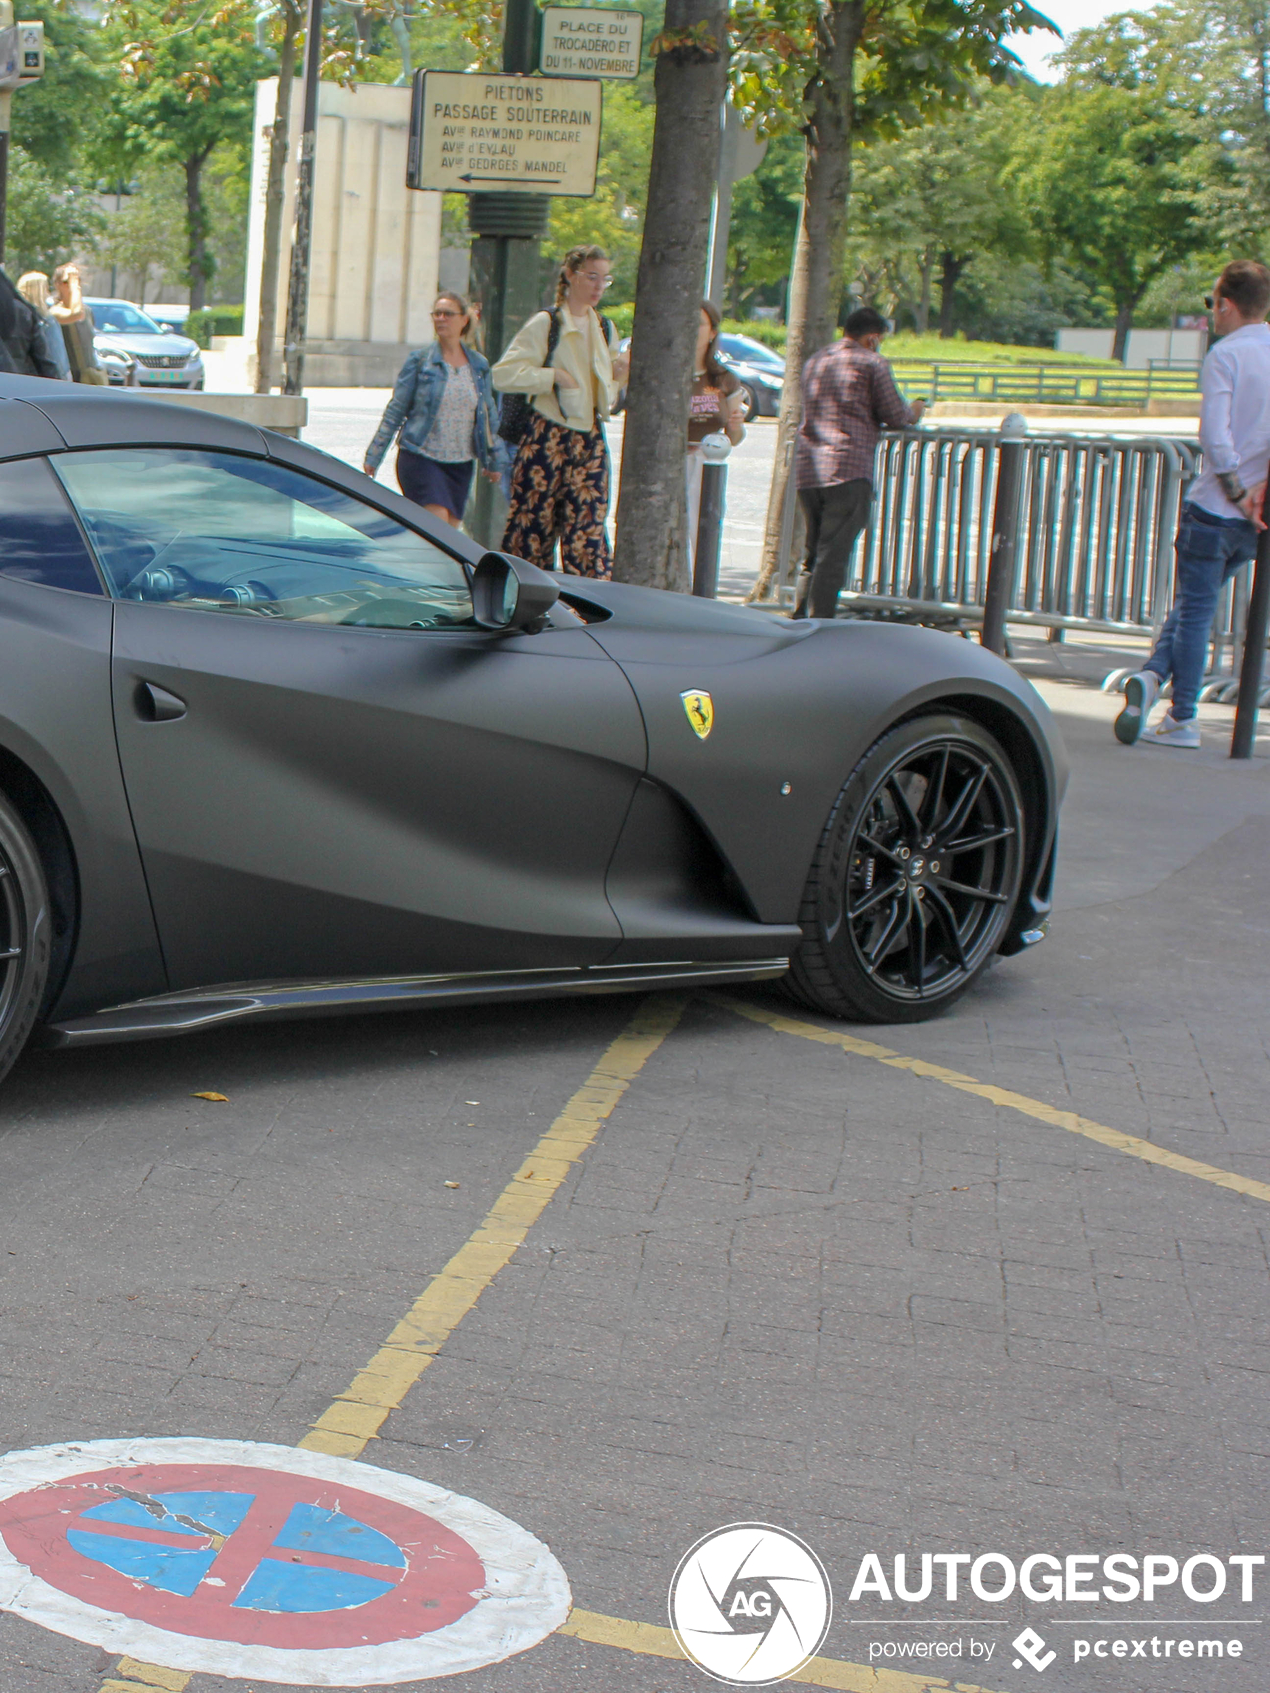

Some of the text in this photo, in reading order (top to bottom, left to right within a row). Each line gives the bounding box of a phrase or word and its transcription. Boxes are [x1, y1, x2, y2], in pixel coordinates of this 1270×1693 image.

[560, 21, 628, 34] PLACE DU
[553, 36, 632, 53] TROCADÉRO ET
[546, 55, 561, 68] DU
[579, 57, 636, 73] NOVEMBRE
[434, 103, 592, 125] PASSAGE SOUTERRAIN
[471, 127, 523, 140] RAYMOND
[469, 158, 519, 171] GEORGES
[525, 161, 568, 174] MANDEL
